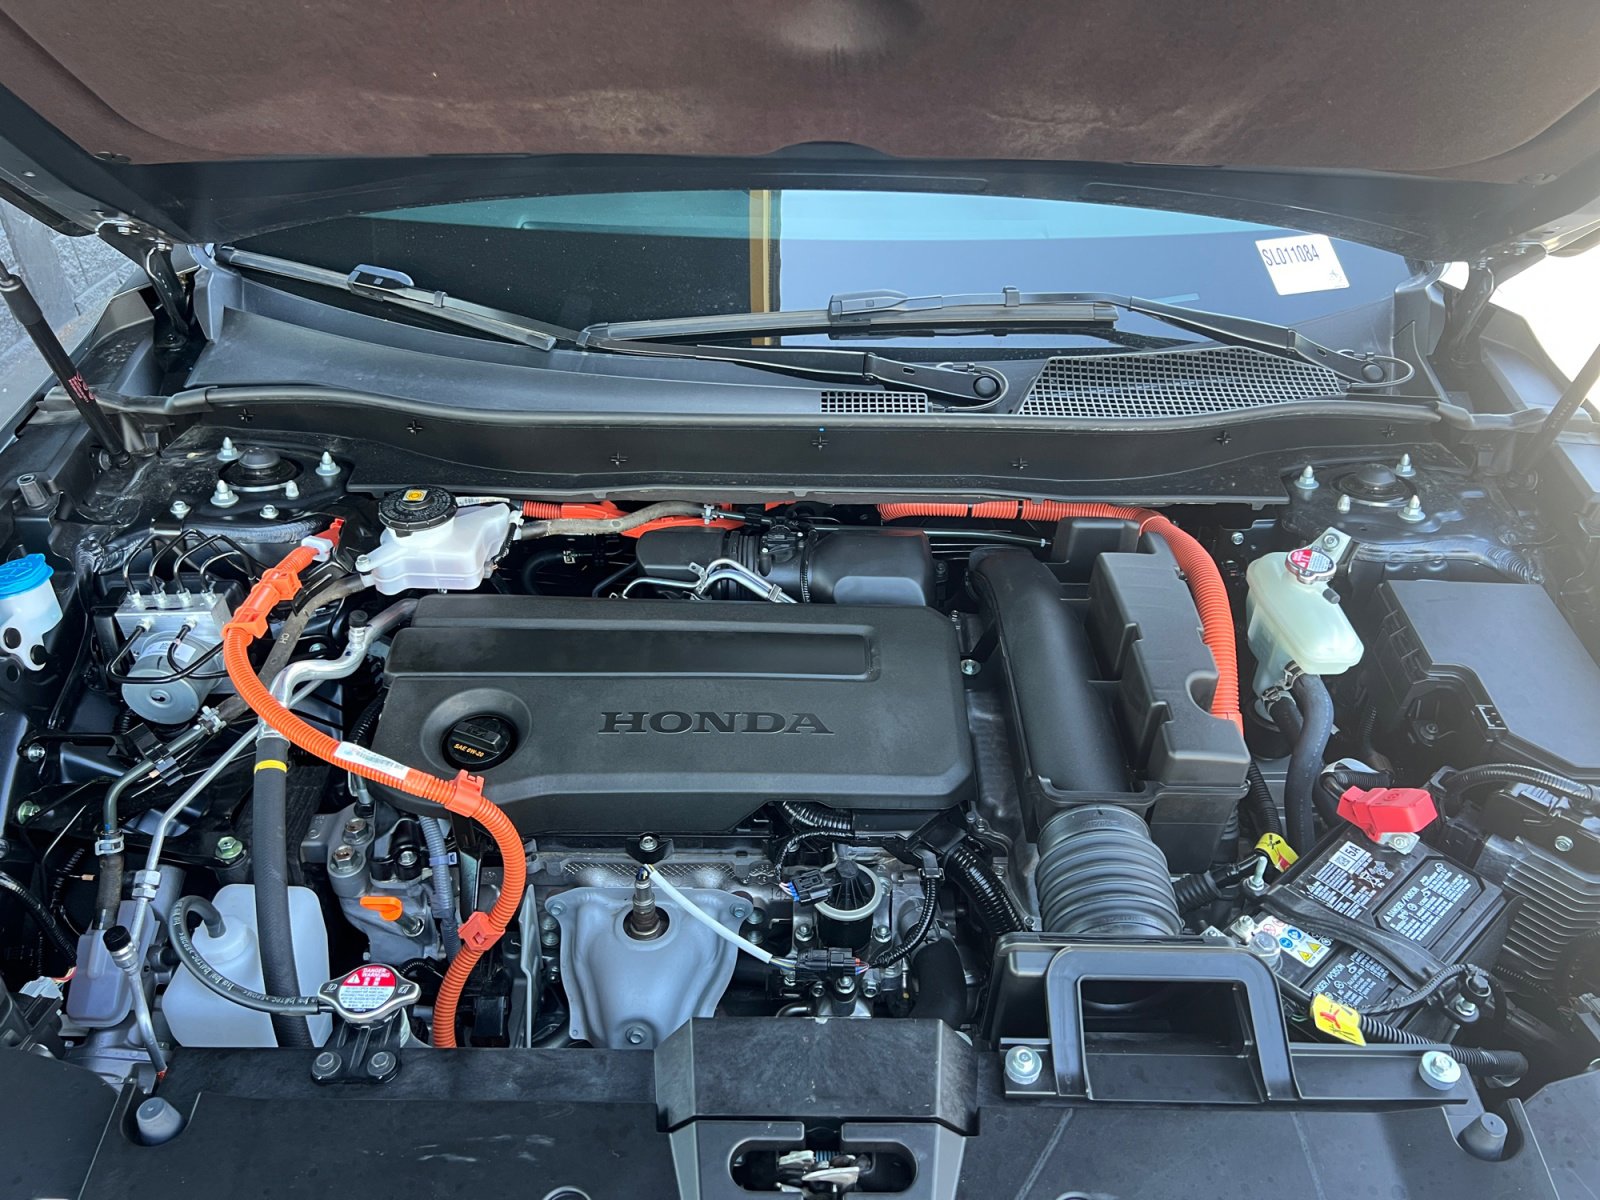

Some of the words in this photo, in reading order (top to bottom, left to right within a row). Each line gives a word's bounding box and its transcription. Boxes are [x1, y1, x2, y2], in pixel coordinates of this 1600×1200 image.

[1261, 244, 1320, 267] SL011084
[598, 710, 835, 736] HONDA
[453, 743, 467, 752] SAE
[1344, 845, 1361, 857] 5A
